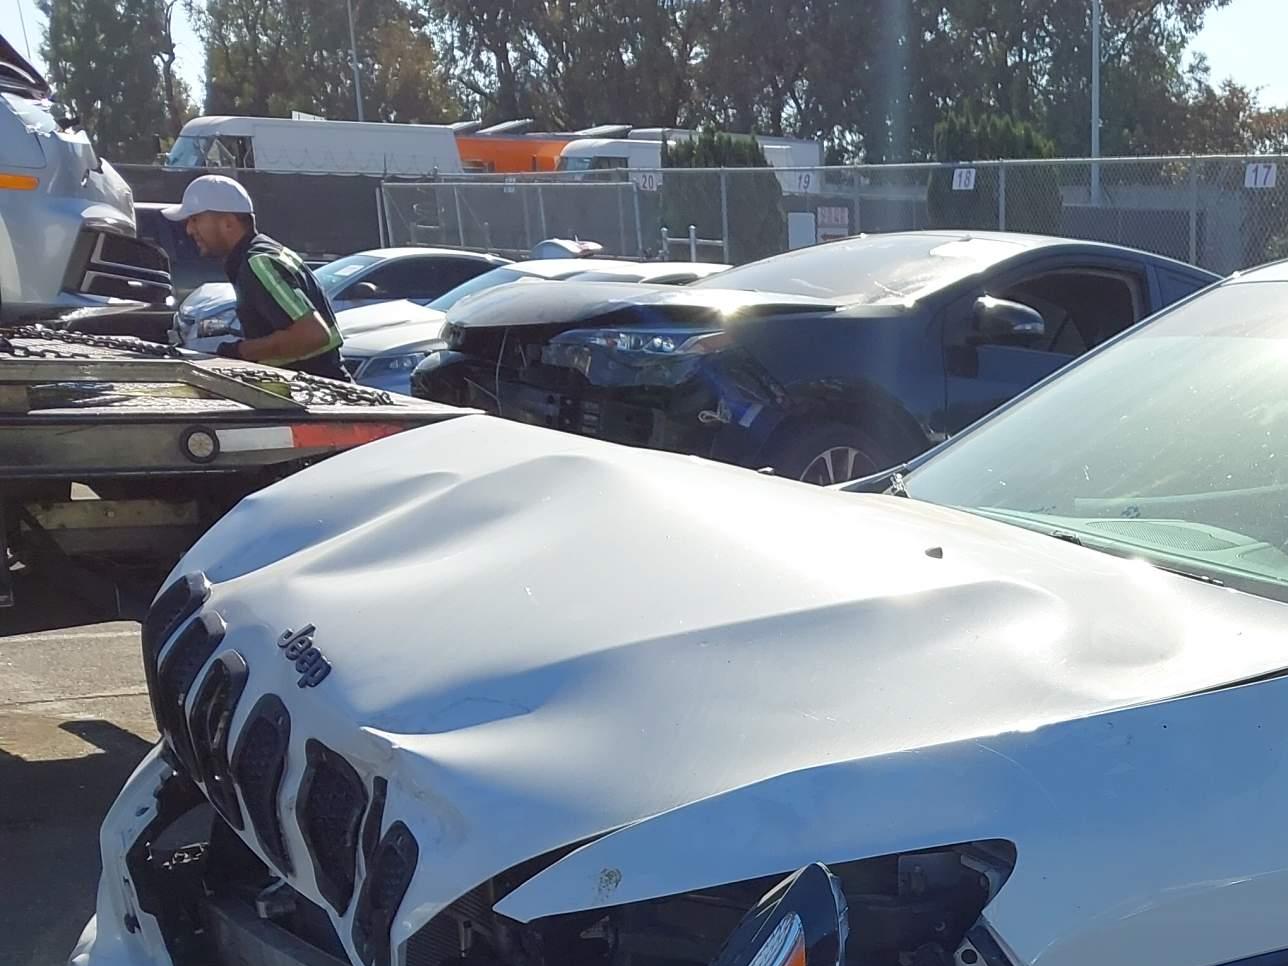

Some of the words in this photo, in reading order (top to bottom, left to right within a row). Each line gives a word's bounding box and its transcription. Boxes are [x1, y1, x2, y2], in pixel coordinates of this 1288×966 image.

[641, 174, 655, 190] 20
[797, 174, 811, 190] 19
[957, 168, 972, 188] 18
[1251, 163, 1273, 186] 17
[277, 623, 333, 689] Jeep
